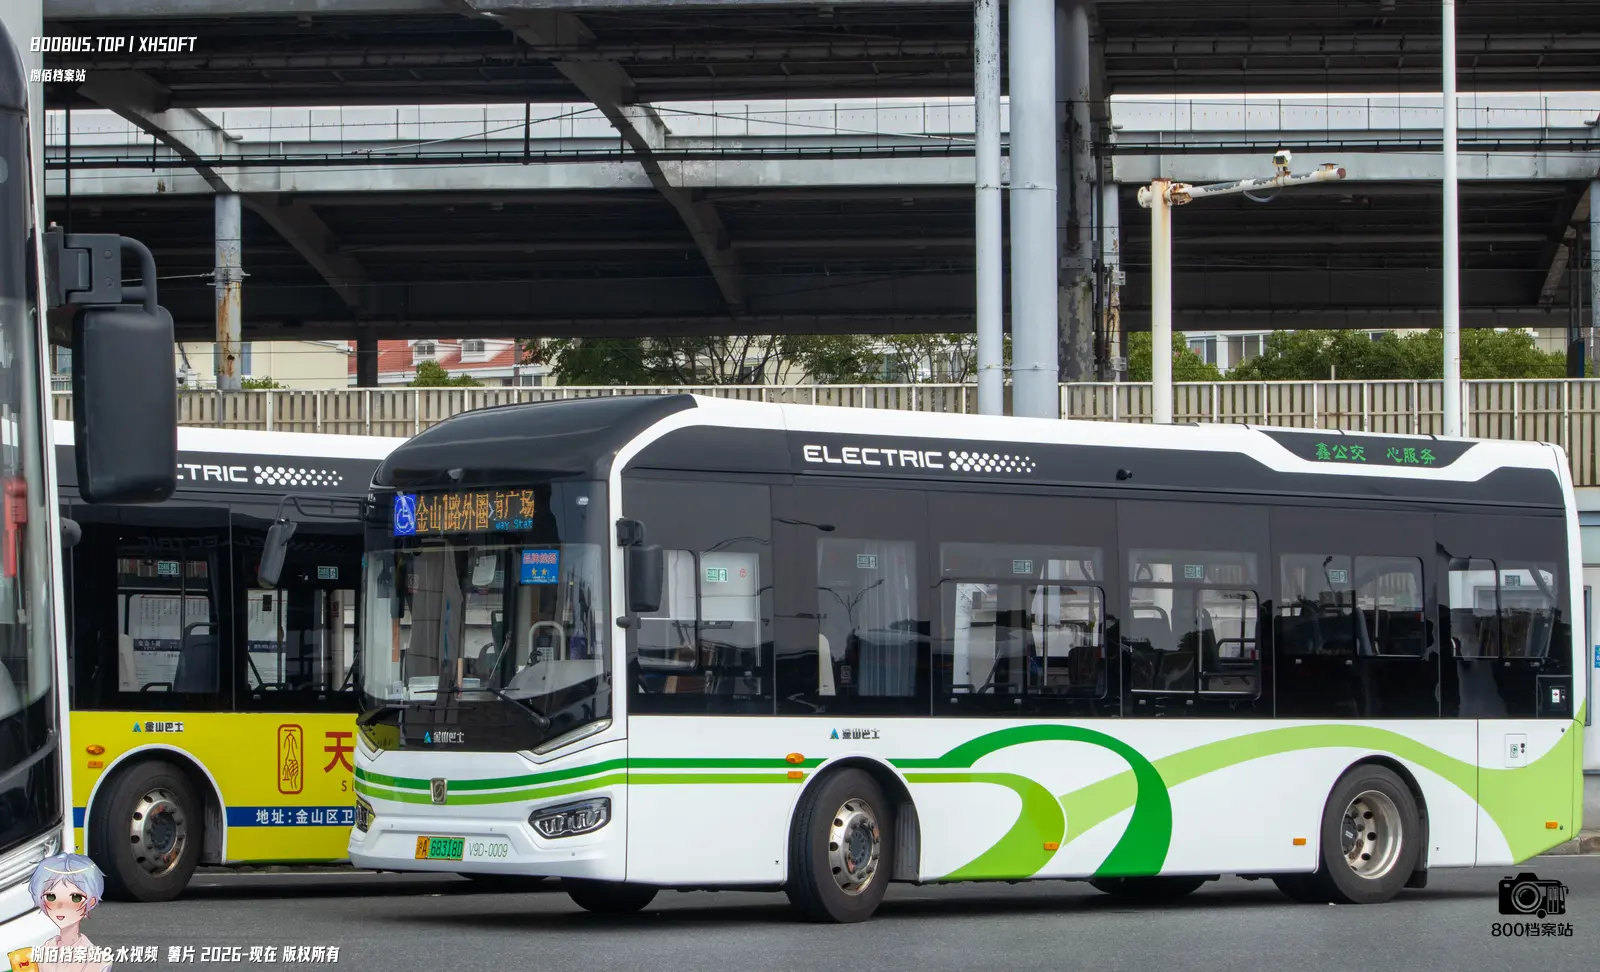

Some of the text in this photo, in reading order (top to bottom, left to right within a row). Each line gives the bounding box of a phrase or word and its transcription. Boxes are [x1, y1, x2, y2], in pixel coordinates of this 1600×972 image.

[803, 445, 944, 469] ELECTRIC
[1315, 442, 1437, 465] 鑫公交 心服务
[144, 721, 184, 733] 金山巴士
[433, 731, 465, 743] 金山巴士
[842, 728, 881, 740] 金山巴士
[469, 843, 508, 858] V9D-0009
